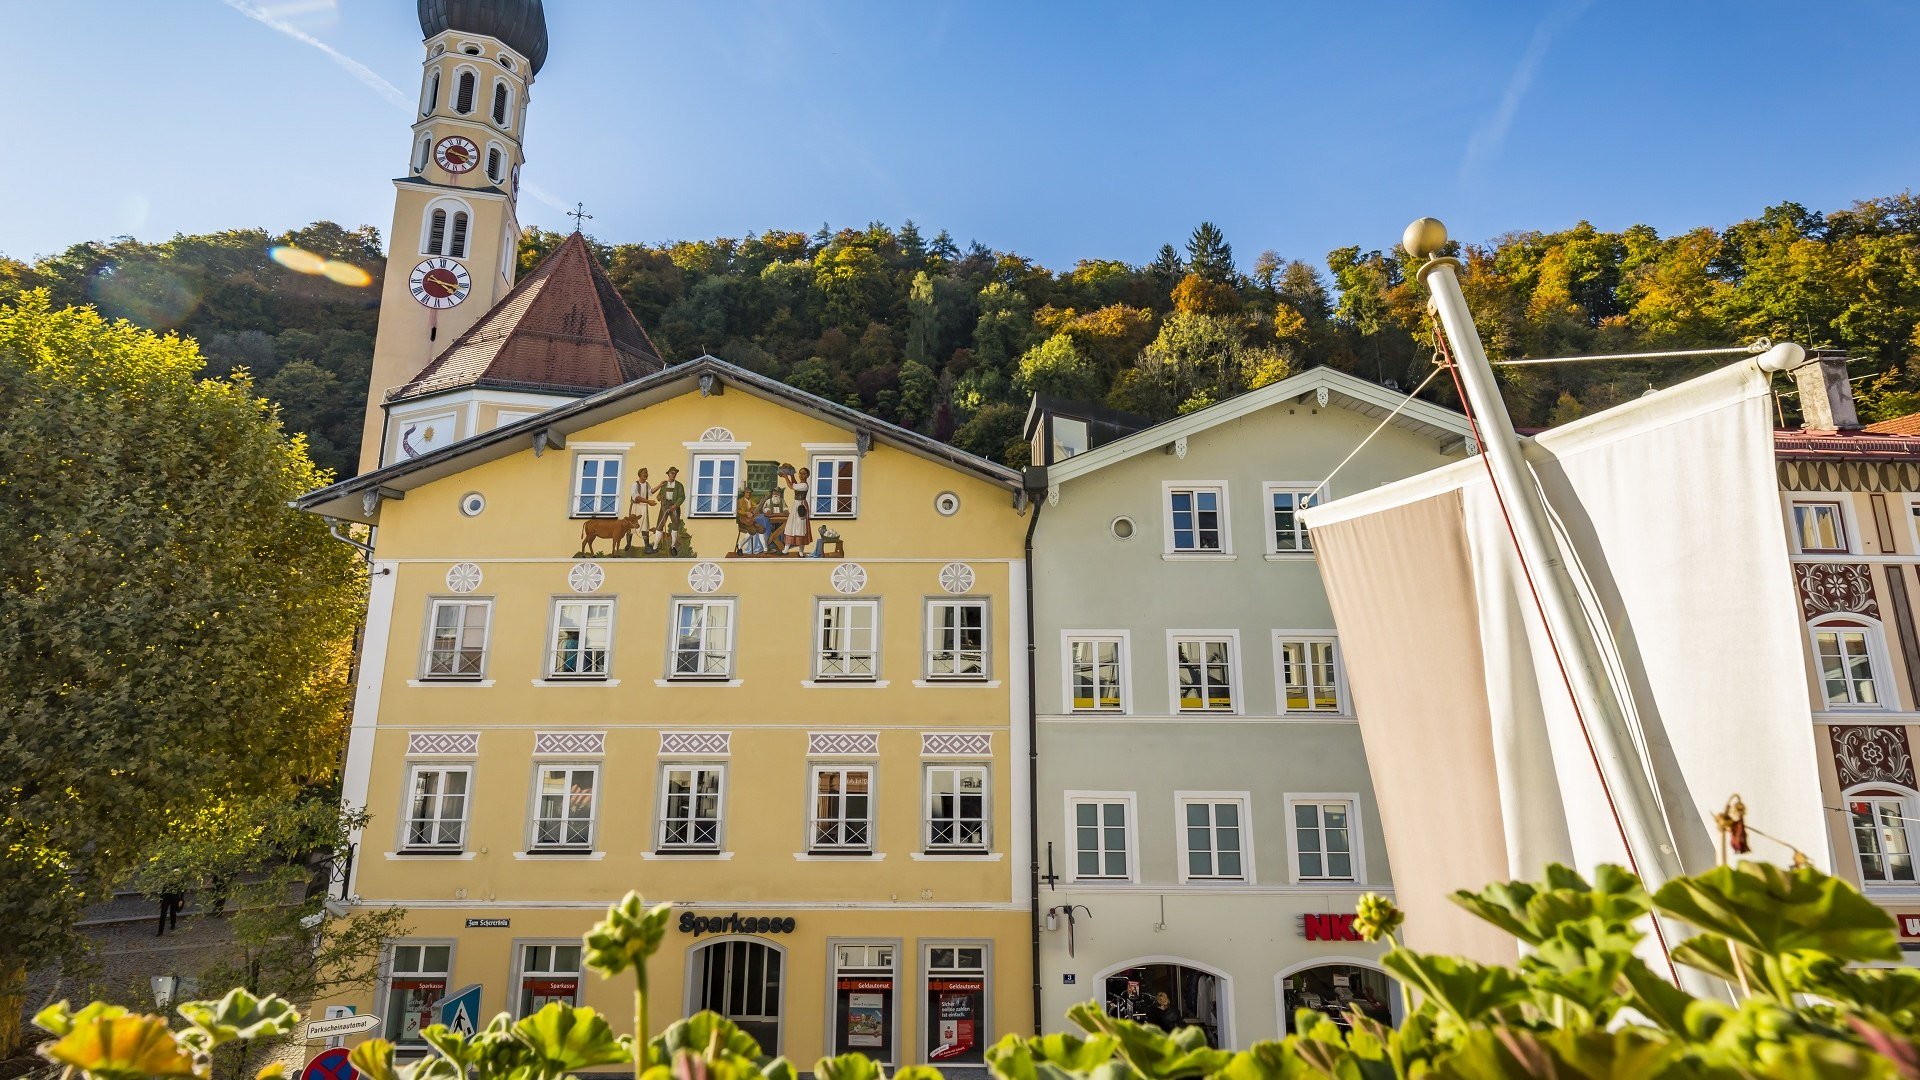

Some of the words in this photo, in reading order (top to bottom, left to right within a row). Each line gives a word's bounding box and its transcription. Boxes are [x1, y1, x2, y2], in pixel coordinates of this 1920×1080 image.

[679, 911, 795, 937] Sparkasse
[1304, 914, 1363, 941] NK
[310, 1021, 367, 1034] Parkscheinautomat
